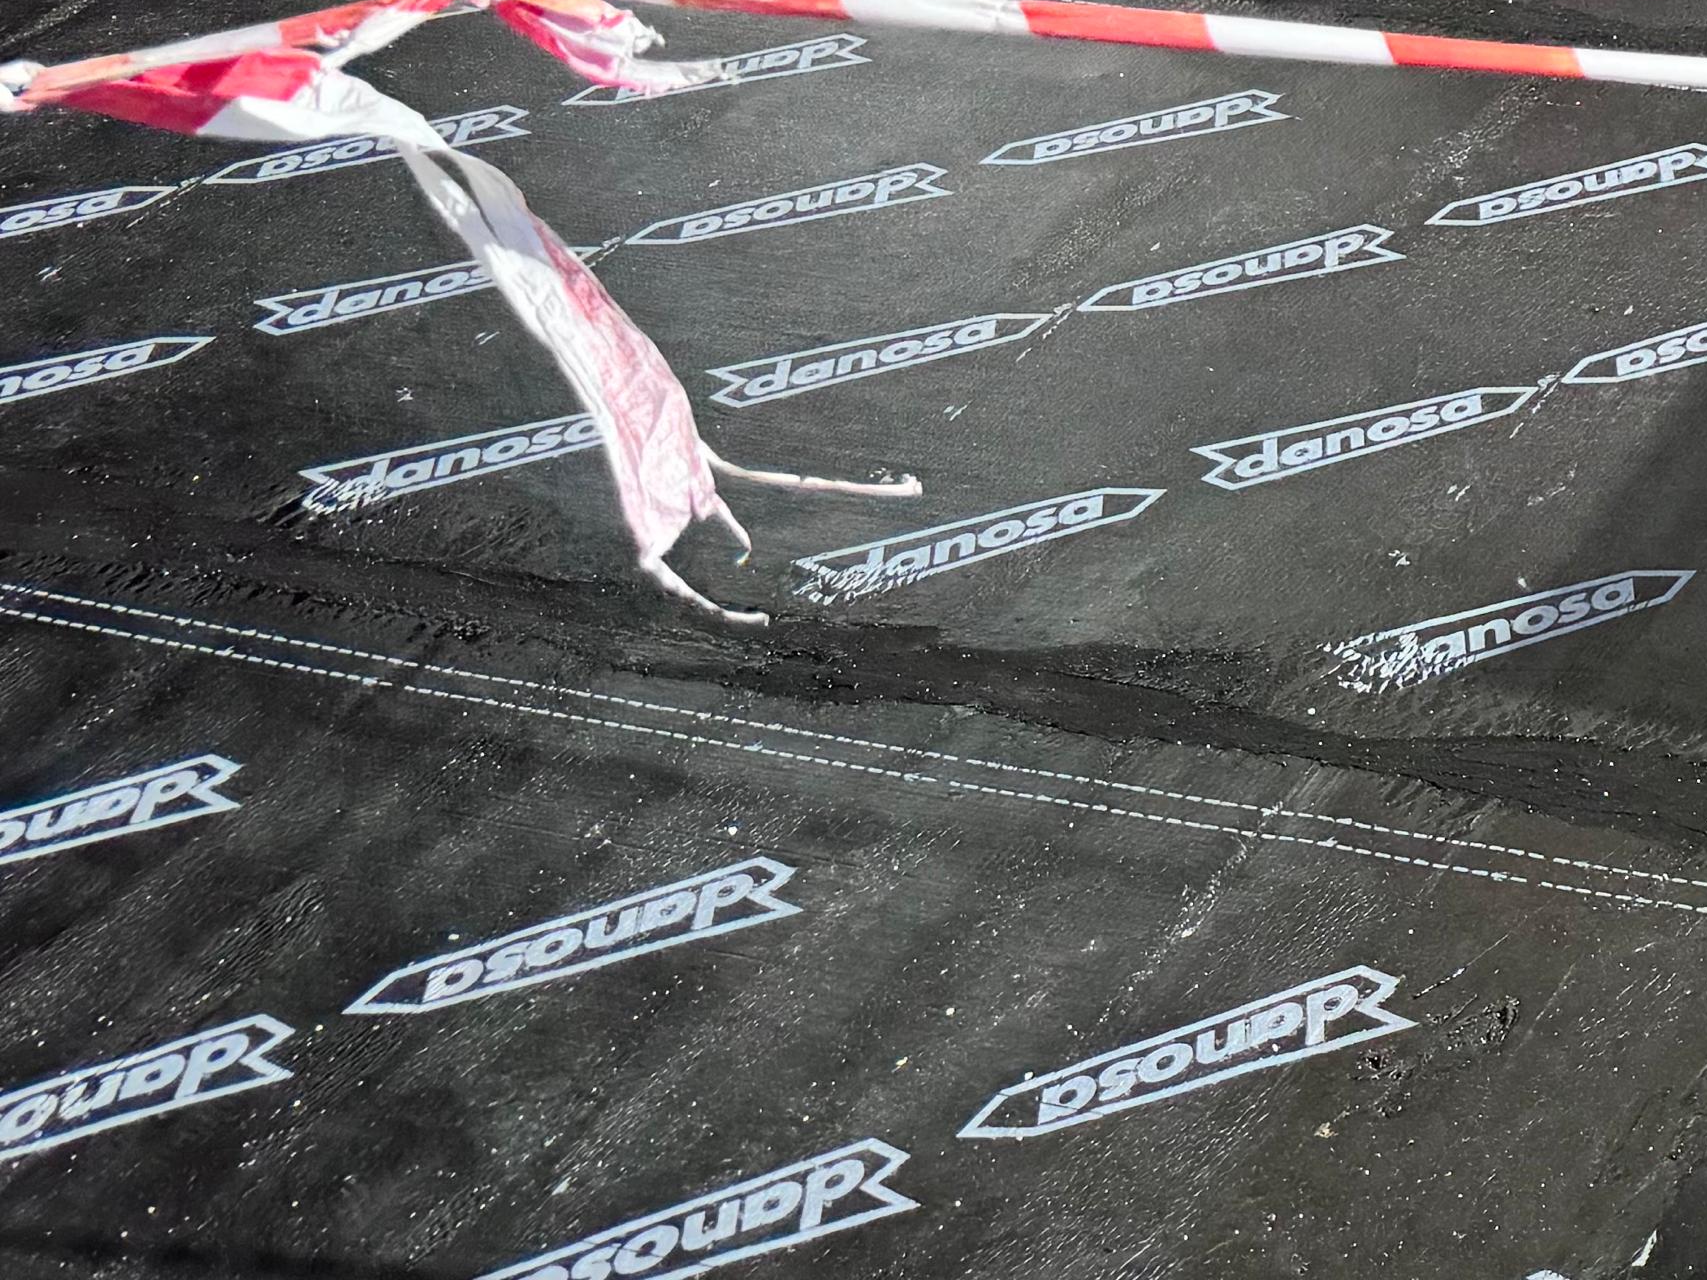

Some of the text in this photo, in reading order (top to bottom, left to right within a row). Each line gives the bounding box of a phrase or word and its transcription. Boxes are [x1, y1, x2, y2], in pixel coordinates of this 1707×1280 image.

[1031, 95, 1263, 161] danosa
[680, 170, 925, 241] danosa
[1475, 150, 1703, 222] danosa
[1132, 231, 1376, 308] danosa
[750, 316, 988, 400] danosa
[1234, 392, 1483, 483] danosa
[422, 871, 756, 1002] danosa
[1041, 982, 1366, 1122] danosa
